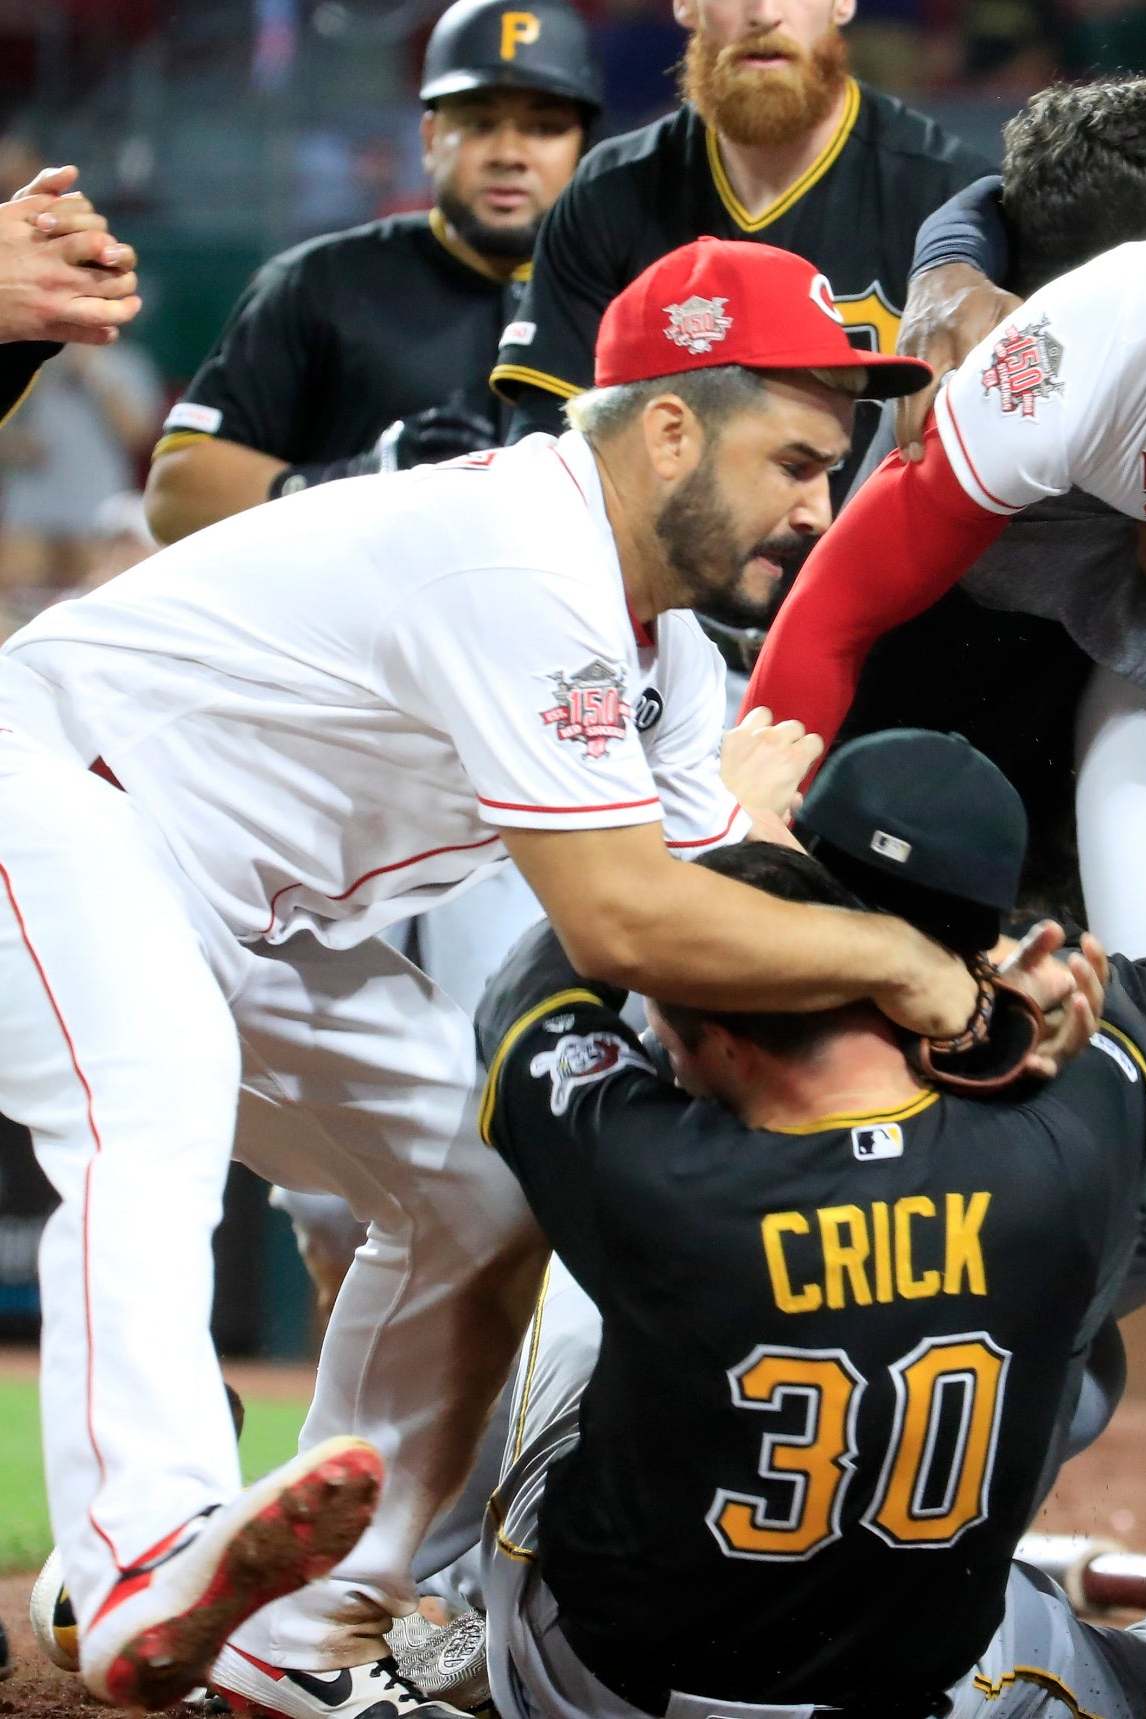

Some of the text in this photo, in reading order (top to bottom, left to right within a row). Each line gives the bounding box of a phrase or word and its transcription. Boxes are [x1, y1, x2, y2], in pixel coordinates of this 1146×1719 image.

[500, 11, 540, 61] P
[1004, 336, 1043, 393] 150
[568, 687, 620, 727] 150
[761, 1191, 992, 1314] CRICK
[705, 1331, 1013, 1562] 30
